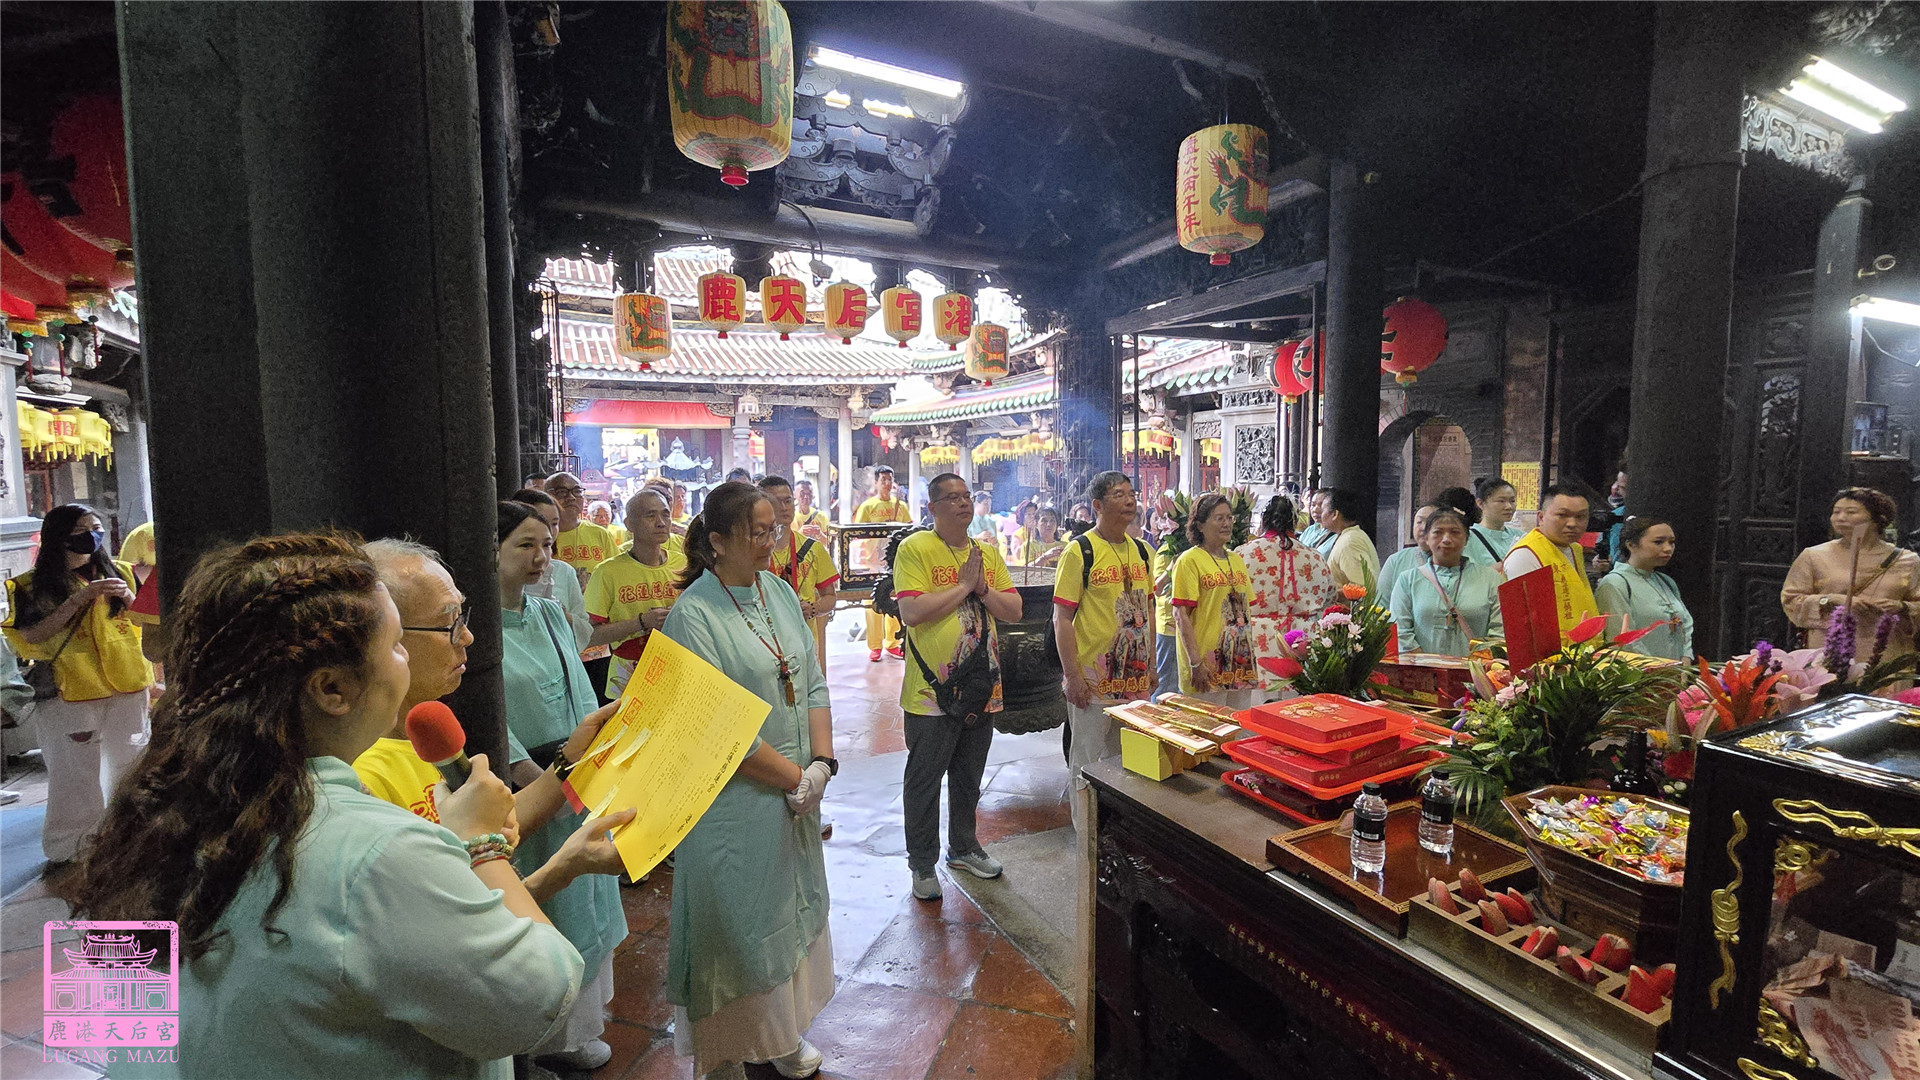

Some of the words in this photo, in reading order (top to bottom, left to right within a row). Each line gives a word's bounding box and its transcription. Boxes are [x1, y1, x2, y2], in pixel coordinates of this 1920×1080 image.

[703, 274, 740, 321] 鹿
[769, 279, 804, 324] 天
[835, 288, 867, 327] 后
[896, 292, 921, 330] 宮
[944, 296, 973, 335] 港
[619, 581, 683, 604] 花蓮慈蓮
